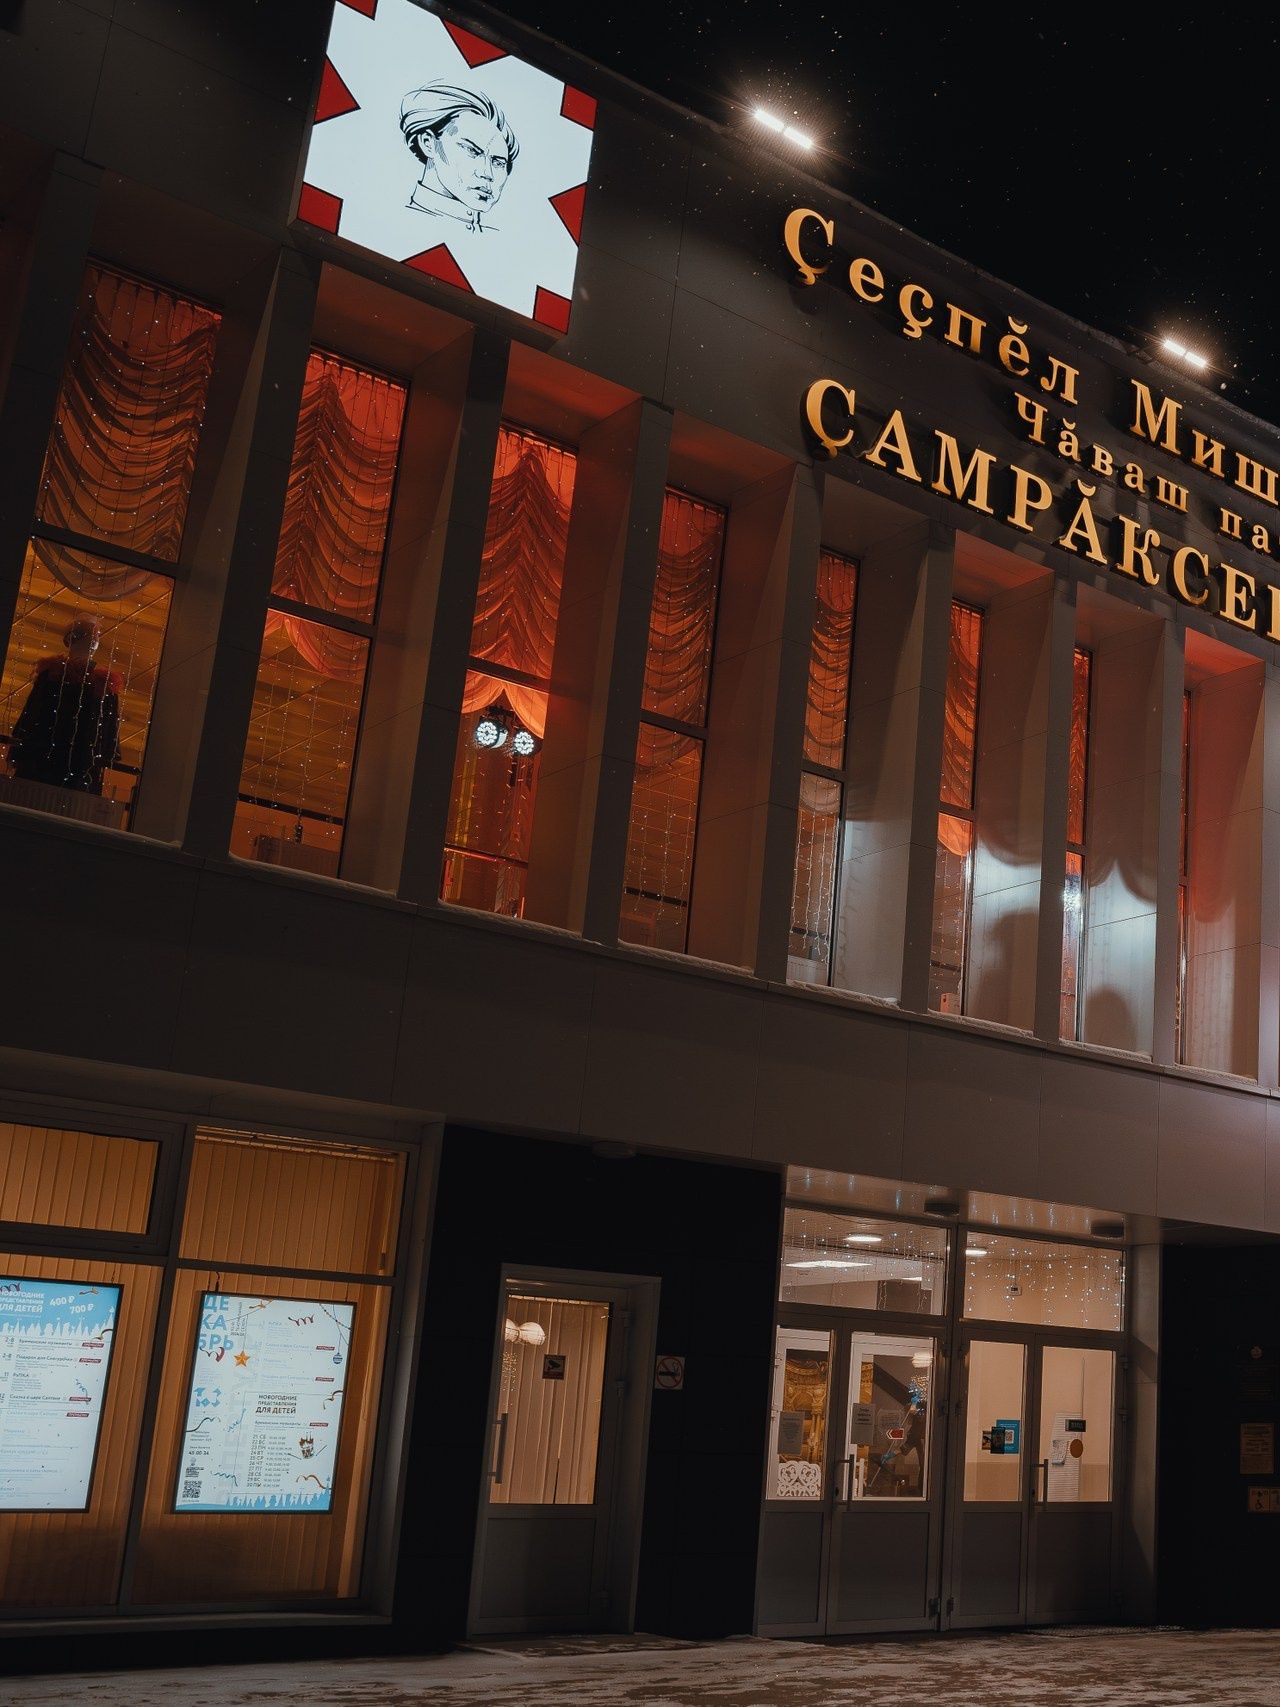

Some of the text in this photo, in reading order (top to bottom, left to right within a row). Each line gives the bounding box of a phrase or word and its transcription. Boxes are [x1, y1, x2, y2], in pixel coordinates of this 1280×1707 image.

[1015, 392, 1189, 513] Чӑваш
[50, 1297, 67, 1306] 400
[69, 1305, 86, 1314] 700
[204, 1295, 230, 1312] ДЕ
[202, 1314, 227, 1331] КА
